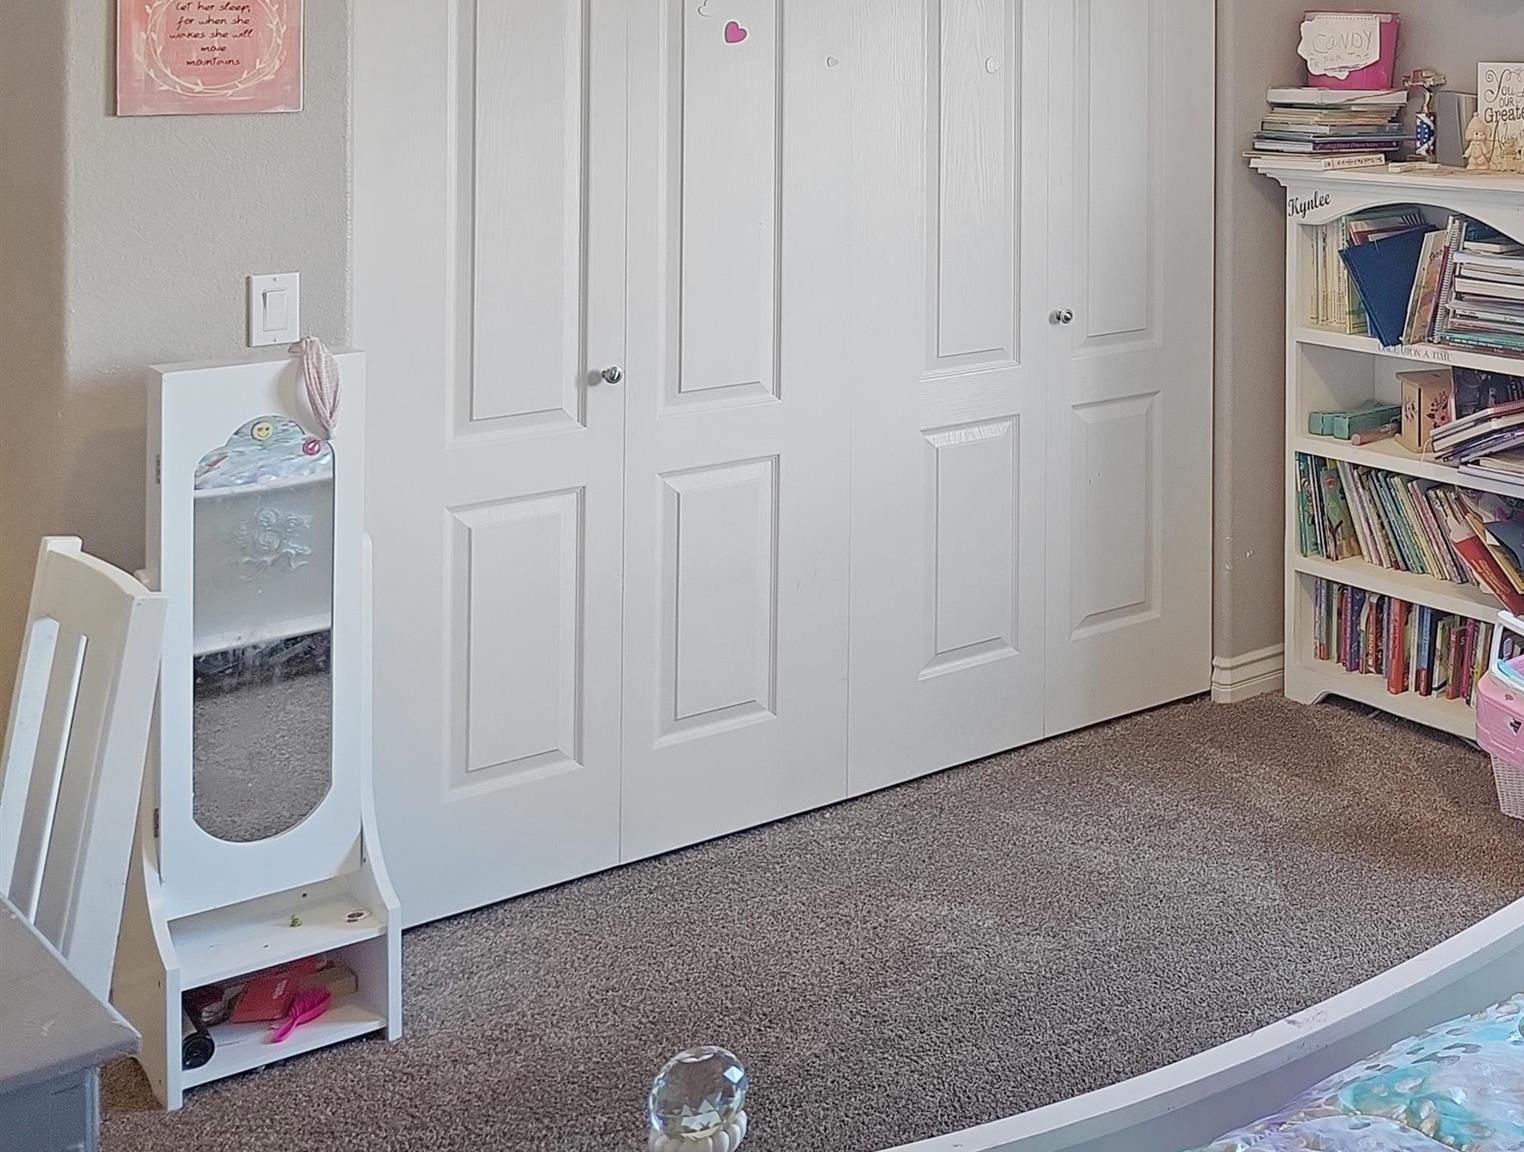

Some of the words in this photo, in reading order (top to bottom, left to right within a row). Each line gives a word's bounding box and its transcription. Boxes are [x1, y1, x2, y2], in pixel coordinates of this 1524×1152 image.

[176, 1, 192, 11] Let
[197, 1, 215, 11] her
[219, 1, 251, 14] sleep,
[177, 16, 194, 31] for
[199, 15, 227, 25] when
[231, 15, 250, 25] she
[210, 28, 229, 39] she
[232, 28, 253, 39] will
[1484, 69, 1515, 103] You
[1288, 191, 1331, 219] Kynlee
